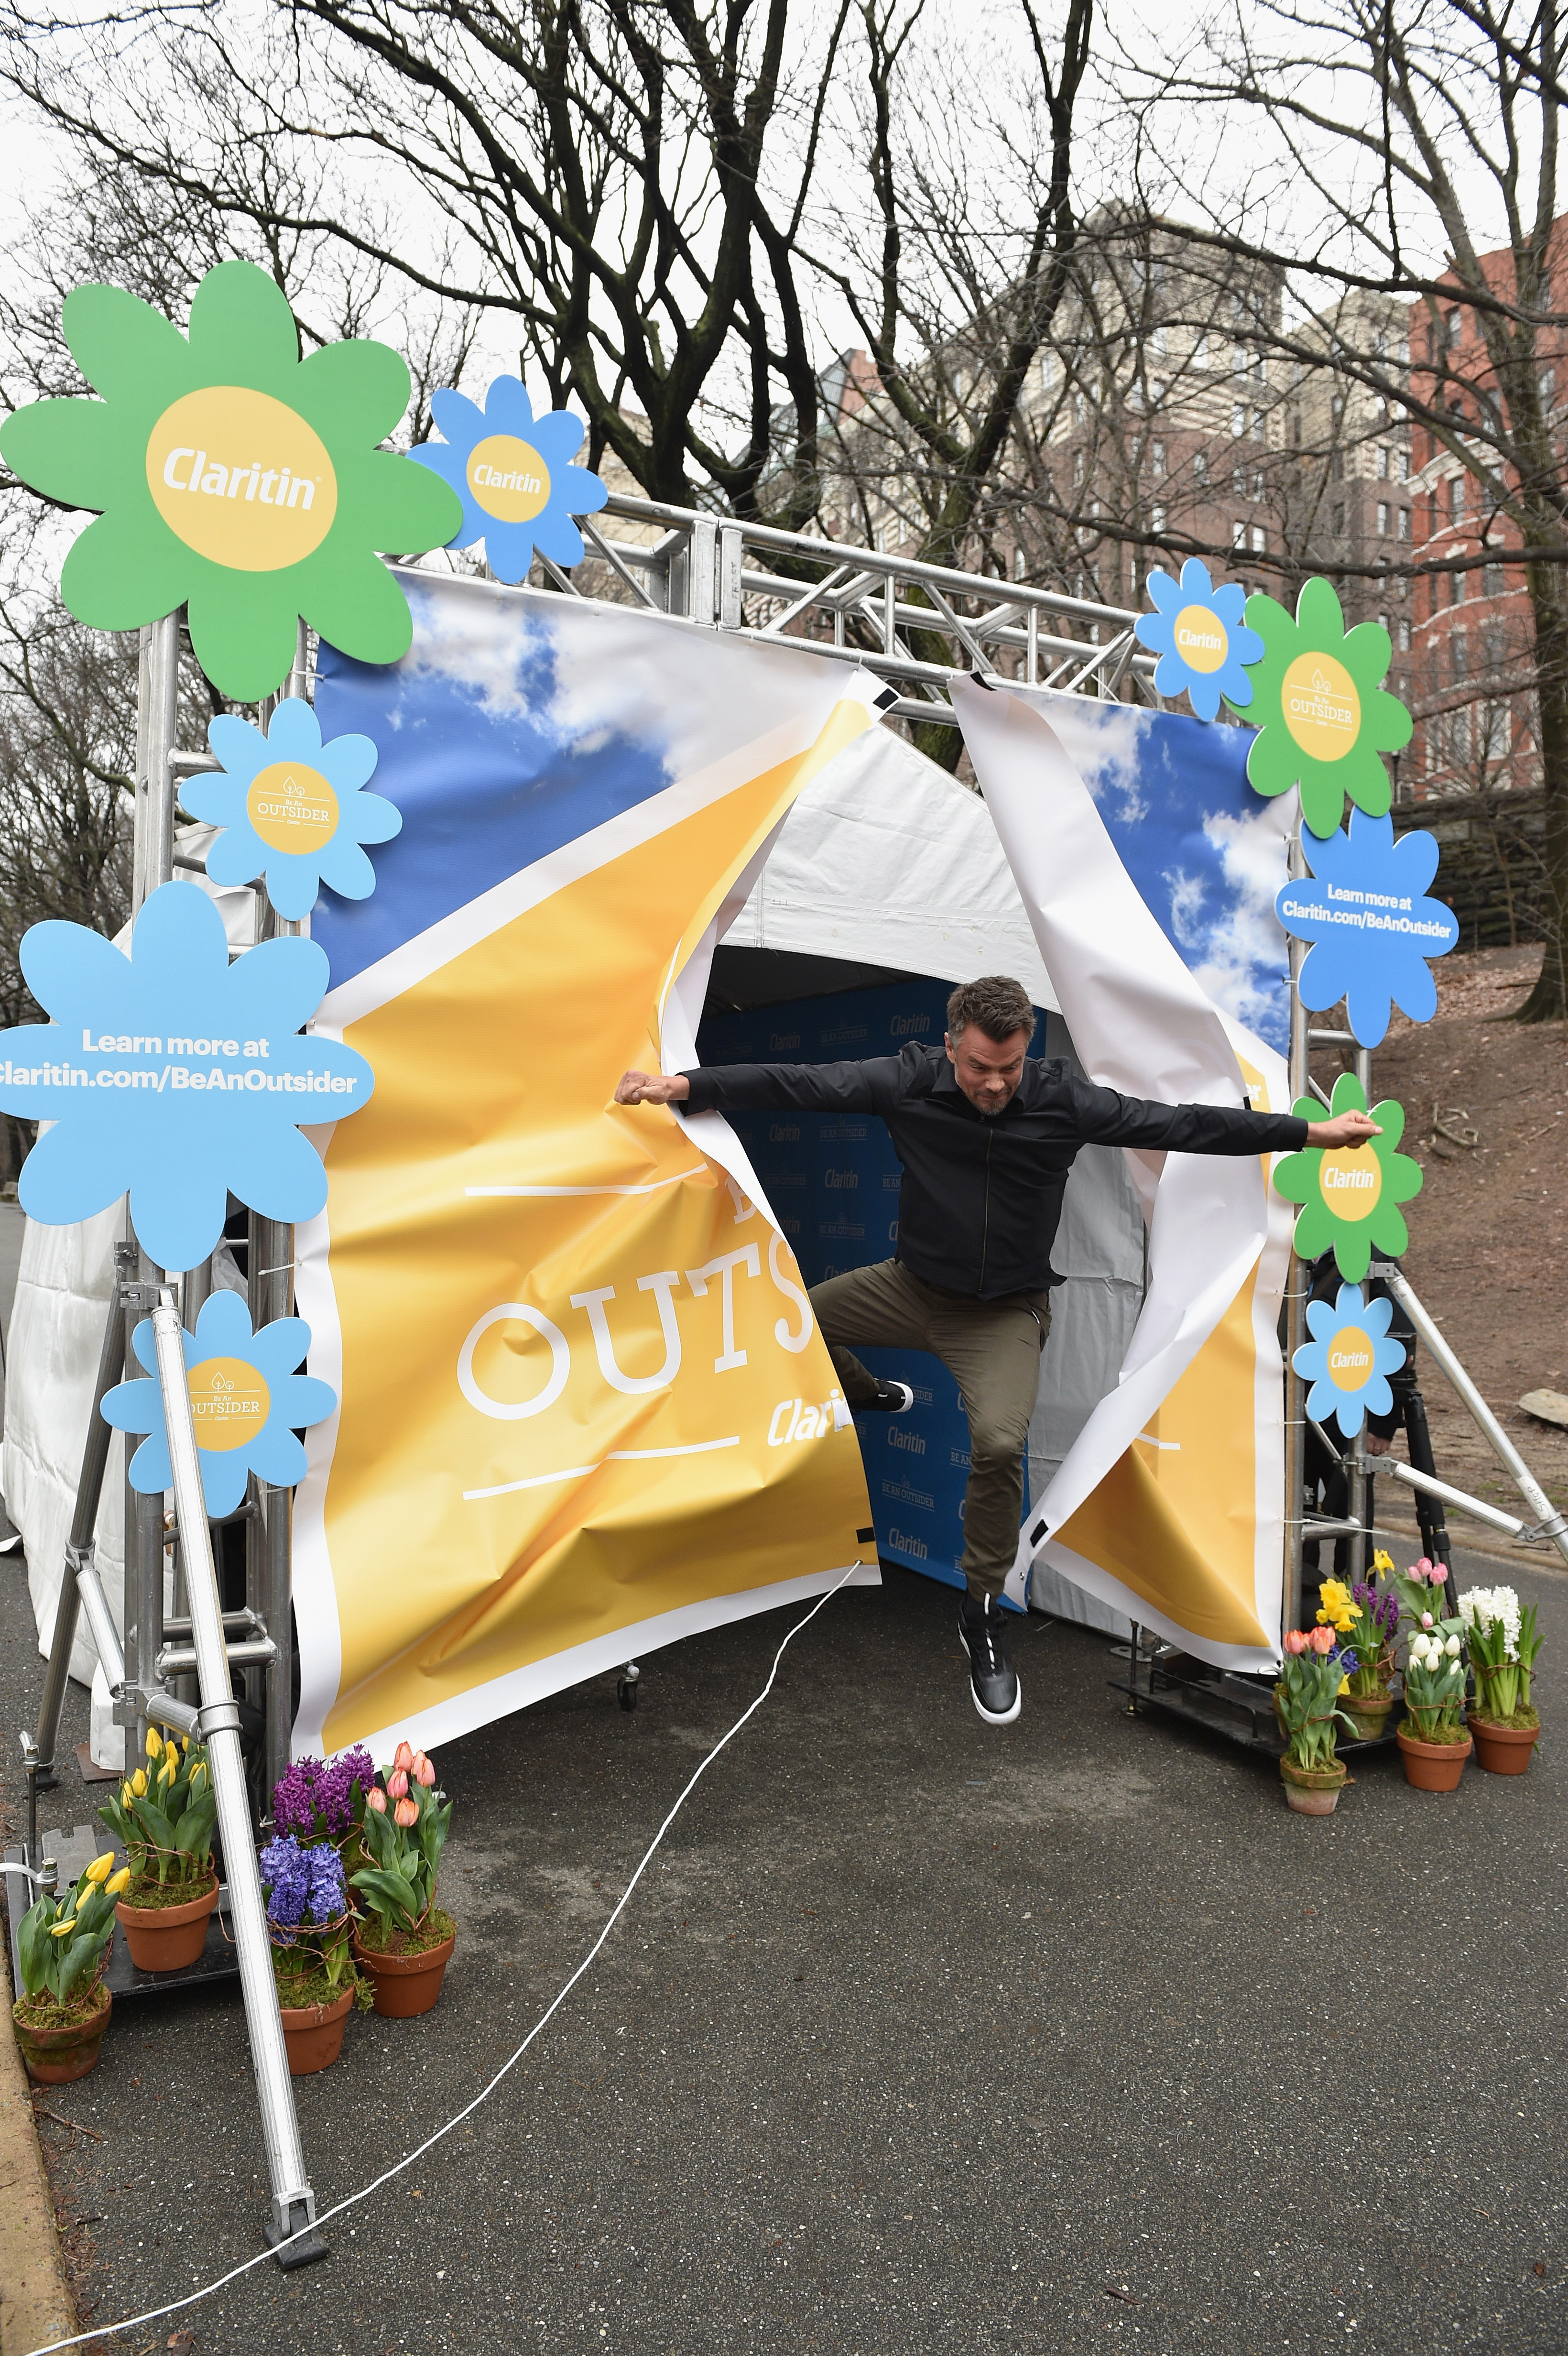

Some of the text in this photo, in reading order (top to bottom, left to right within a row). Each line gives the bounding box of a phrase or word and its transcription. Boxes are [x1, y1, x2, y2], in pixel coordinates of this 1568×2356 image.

[474, 464, 541, 494] Claritin
[1178, 628, 1222, 650] Claritin
[1290, 698, 1352, 724] OUTSIDER
[258, 802, 329, 822] OUTSIDER
[1327, 883, 1412, 911] Learn more at
[1282, 900, 1451, 938] Claritin.com/BeAnOutsider
[891, 1013, 930, 1036] Claritin
[82, 1029, 269, 1058] Learn more at
[770, 1032, 801, 1052] Claritin
[769, 1123, 801, 1142] Claritin
[825, 1168, 858, 1189] Claritin
[882, 1178, 900, 1187] BE AN
[1324, 1167, 1374, 1188] Claritin
[1330, 1351, 1369, 1368] Claritin
[888, 1426, 926, 1455] Claritin
[950, 1451, 959, 1463] BE
[882, 1483, 934, 1508] BE AN OUTSIDER
[889, 1527, 927, 1560] Claritin
